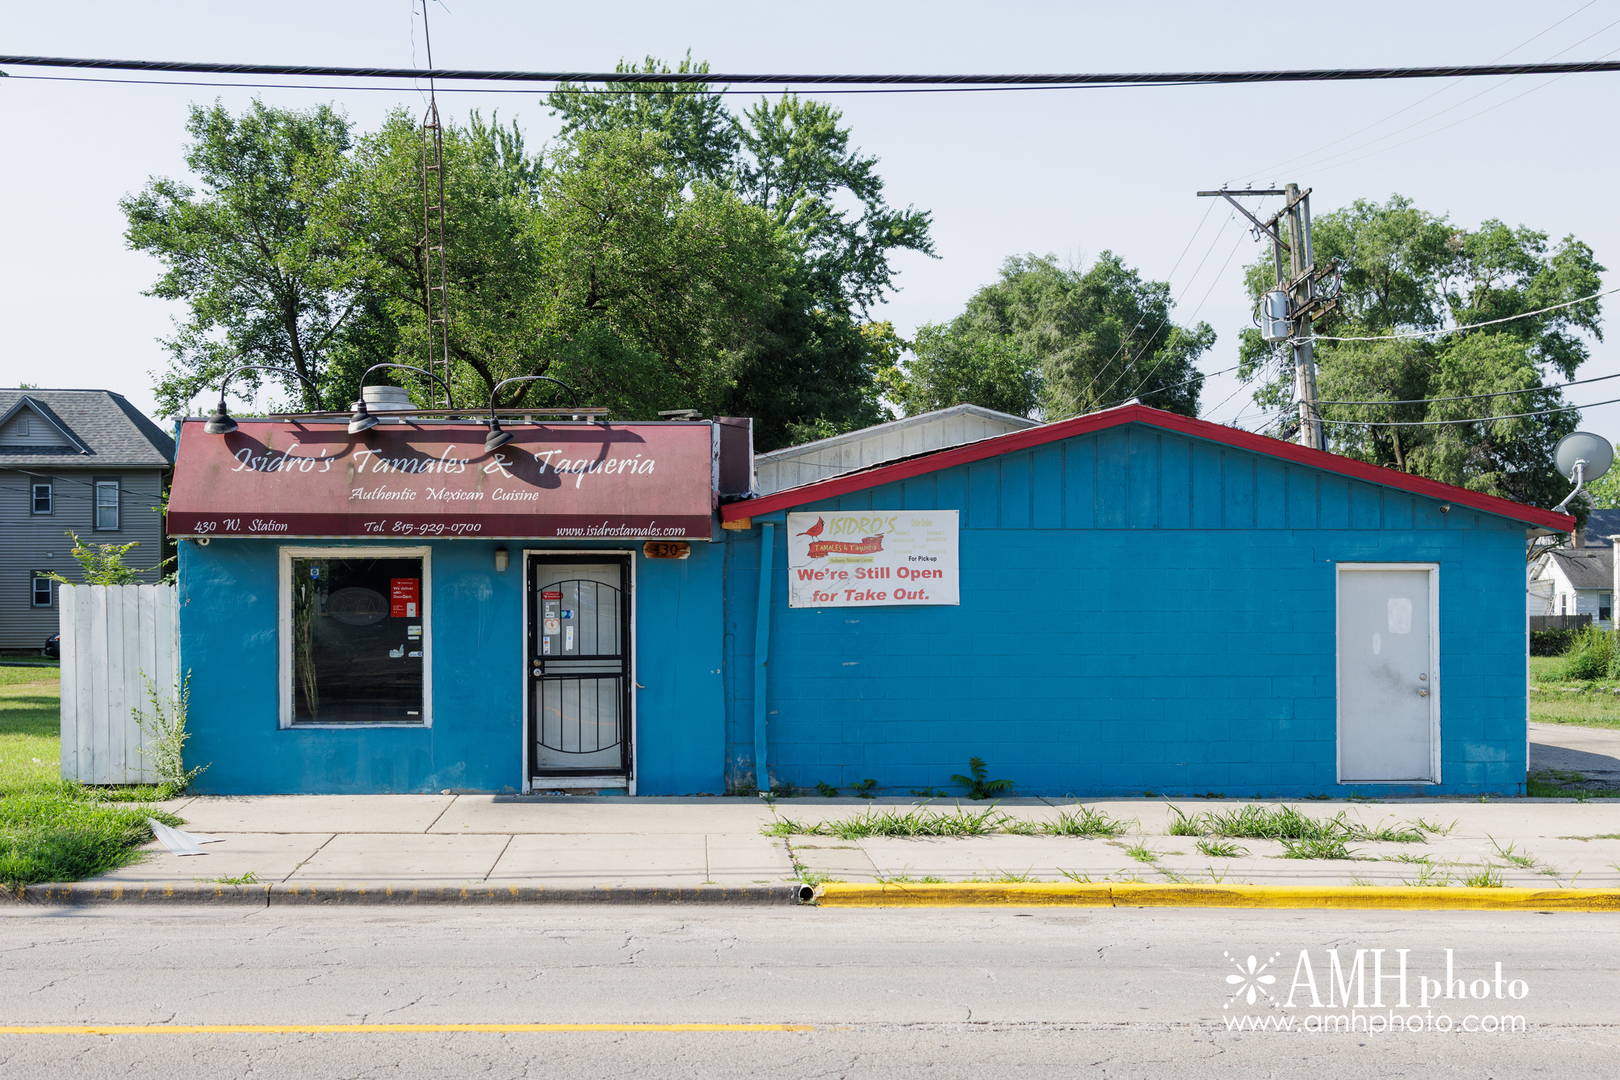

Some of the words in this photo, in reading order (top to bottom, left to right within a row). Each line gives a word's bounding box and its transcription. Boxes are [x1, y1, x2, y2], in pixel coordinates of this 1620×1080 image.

[231, 443, 335, 473] Isidro's
[353, 445, 469, 474] Tamales
[483, 453, 514, 479] &
[349, 485, 416, 501] Authentic
[426, 487, 484, 502] Mexican
[492, 487, 539, 501] Cuisine
[194, 521, 217, 533] 430
[223, 518, 241, 532] W.
[248, 519, 288, 532] Station
[364, 520, 387, 532] Tel.
[392, 521, 482, 535] 815-929-0700
[556, 521, 686, 536] www.isidrostamales.com
[829, 516, 898, 536] ISIDRO'S
[654, 544, 678, 556] 430
[815, 544, 842, 552] TAMALES
[918, 555, 937, 563] Pick-up
[797, 567, 849, 581] We're
[854, 567, 890, 579] Still
[896, 566, 943, 581] Open
[812, 590, 838, 602] for
[844, 589, 887, 601] Take
[893, 588, 929, 600] Out.
[331, 597, 383, 614] OPEN
